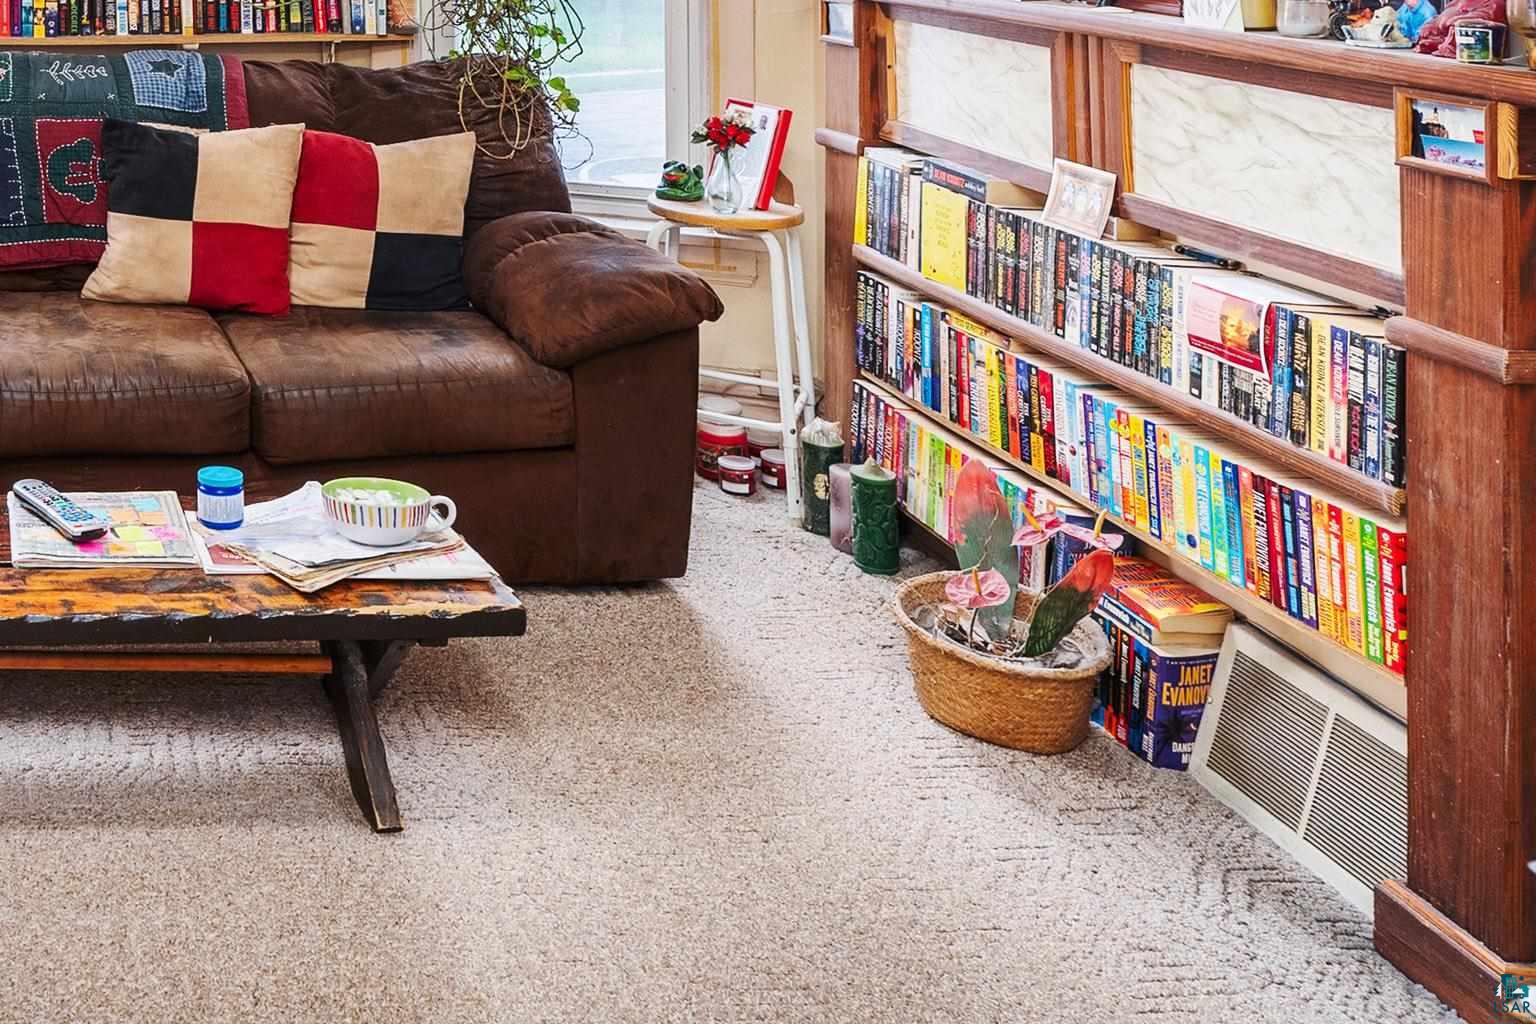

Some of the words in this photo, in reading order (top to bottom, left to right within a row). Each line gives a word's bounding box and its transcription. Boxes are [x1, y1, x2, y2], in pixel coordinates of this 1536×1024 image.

[1112, 304, 1121, 326] NIGHT
[1278, 319, 1286, 338] DEAN
[1277, 340, 1286, 366] KOONTZ
[1317, 335, 1326, 357] DEAN
[1334, 340, 1344, 364] DEAN
[1349, 346, 1364, 370] DEAN
[1317, 360, 1326, 391] KOONTZ
[1368, 356, 1379, 374] DEAN
[1386, 359, 1397, 384] DEAN
[988, 385, 998, 401] TESS
[1333, 365, 1343, 399] KOONTZ
[1348, 372, 1364, 405] KOONTZ
[1386, 385, 1397, 420] KOONTZ
[988, 402, 998, 442] GERRITSEN
[1317, 396, 1326, 438] INTENSITY
[1021, 426, 1030, 460] VANISH
[1252, 491, 1266, 522] JANET
[1256, 522, 1269, 570] EVANOVICH
[1299, 520, 1310, 544] JANET
[1302, 546, 1312, 586] EVANOVICH
[1365, 550, 1376, 575] Janet
[1382, 558, 1392, 584] Janet
[1366, 577, 1378, 624] Evanovich
[1384, 587, 1396, 633] Evanovich
[1178, 663, 1213, 686] JANET
[1133, 676, 1142, 709] EVANOVICH
[1147, 689, 1156, 721] EVANOVICH
[1161, 682, 1212, 706] EVANOV
